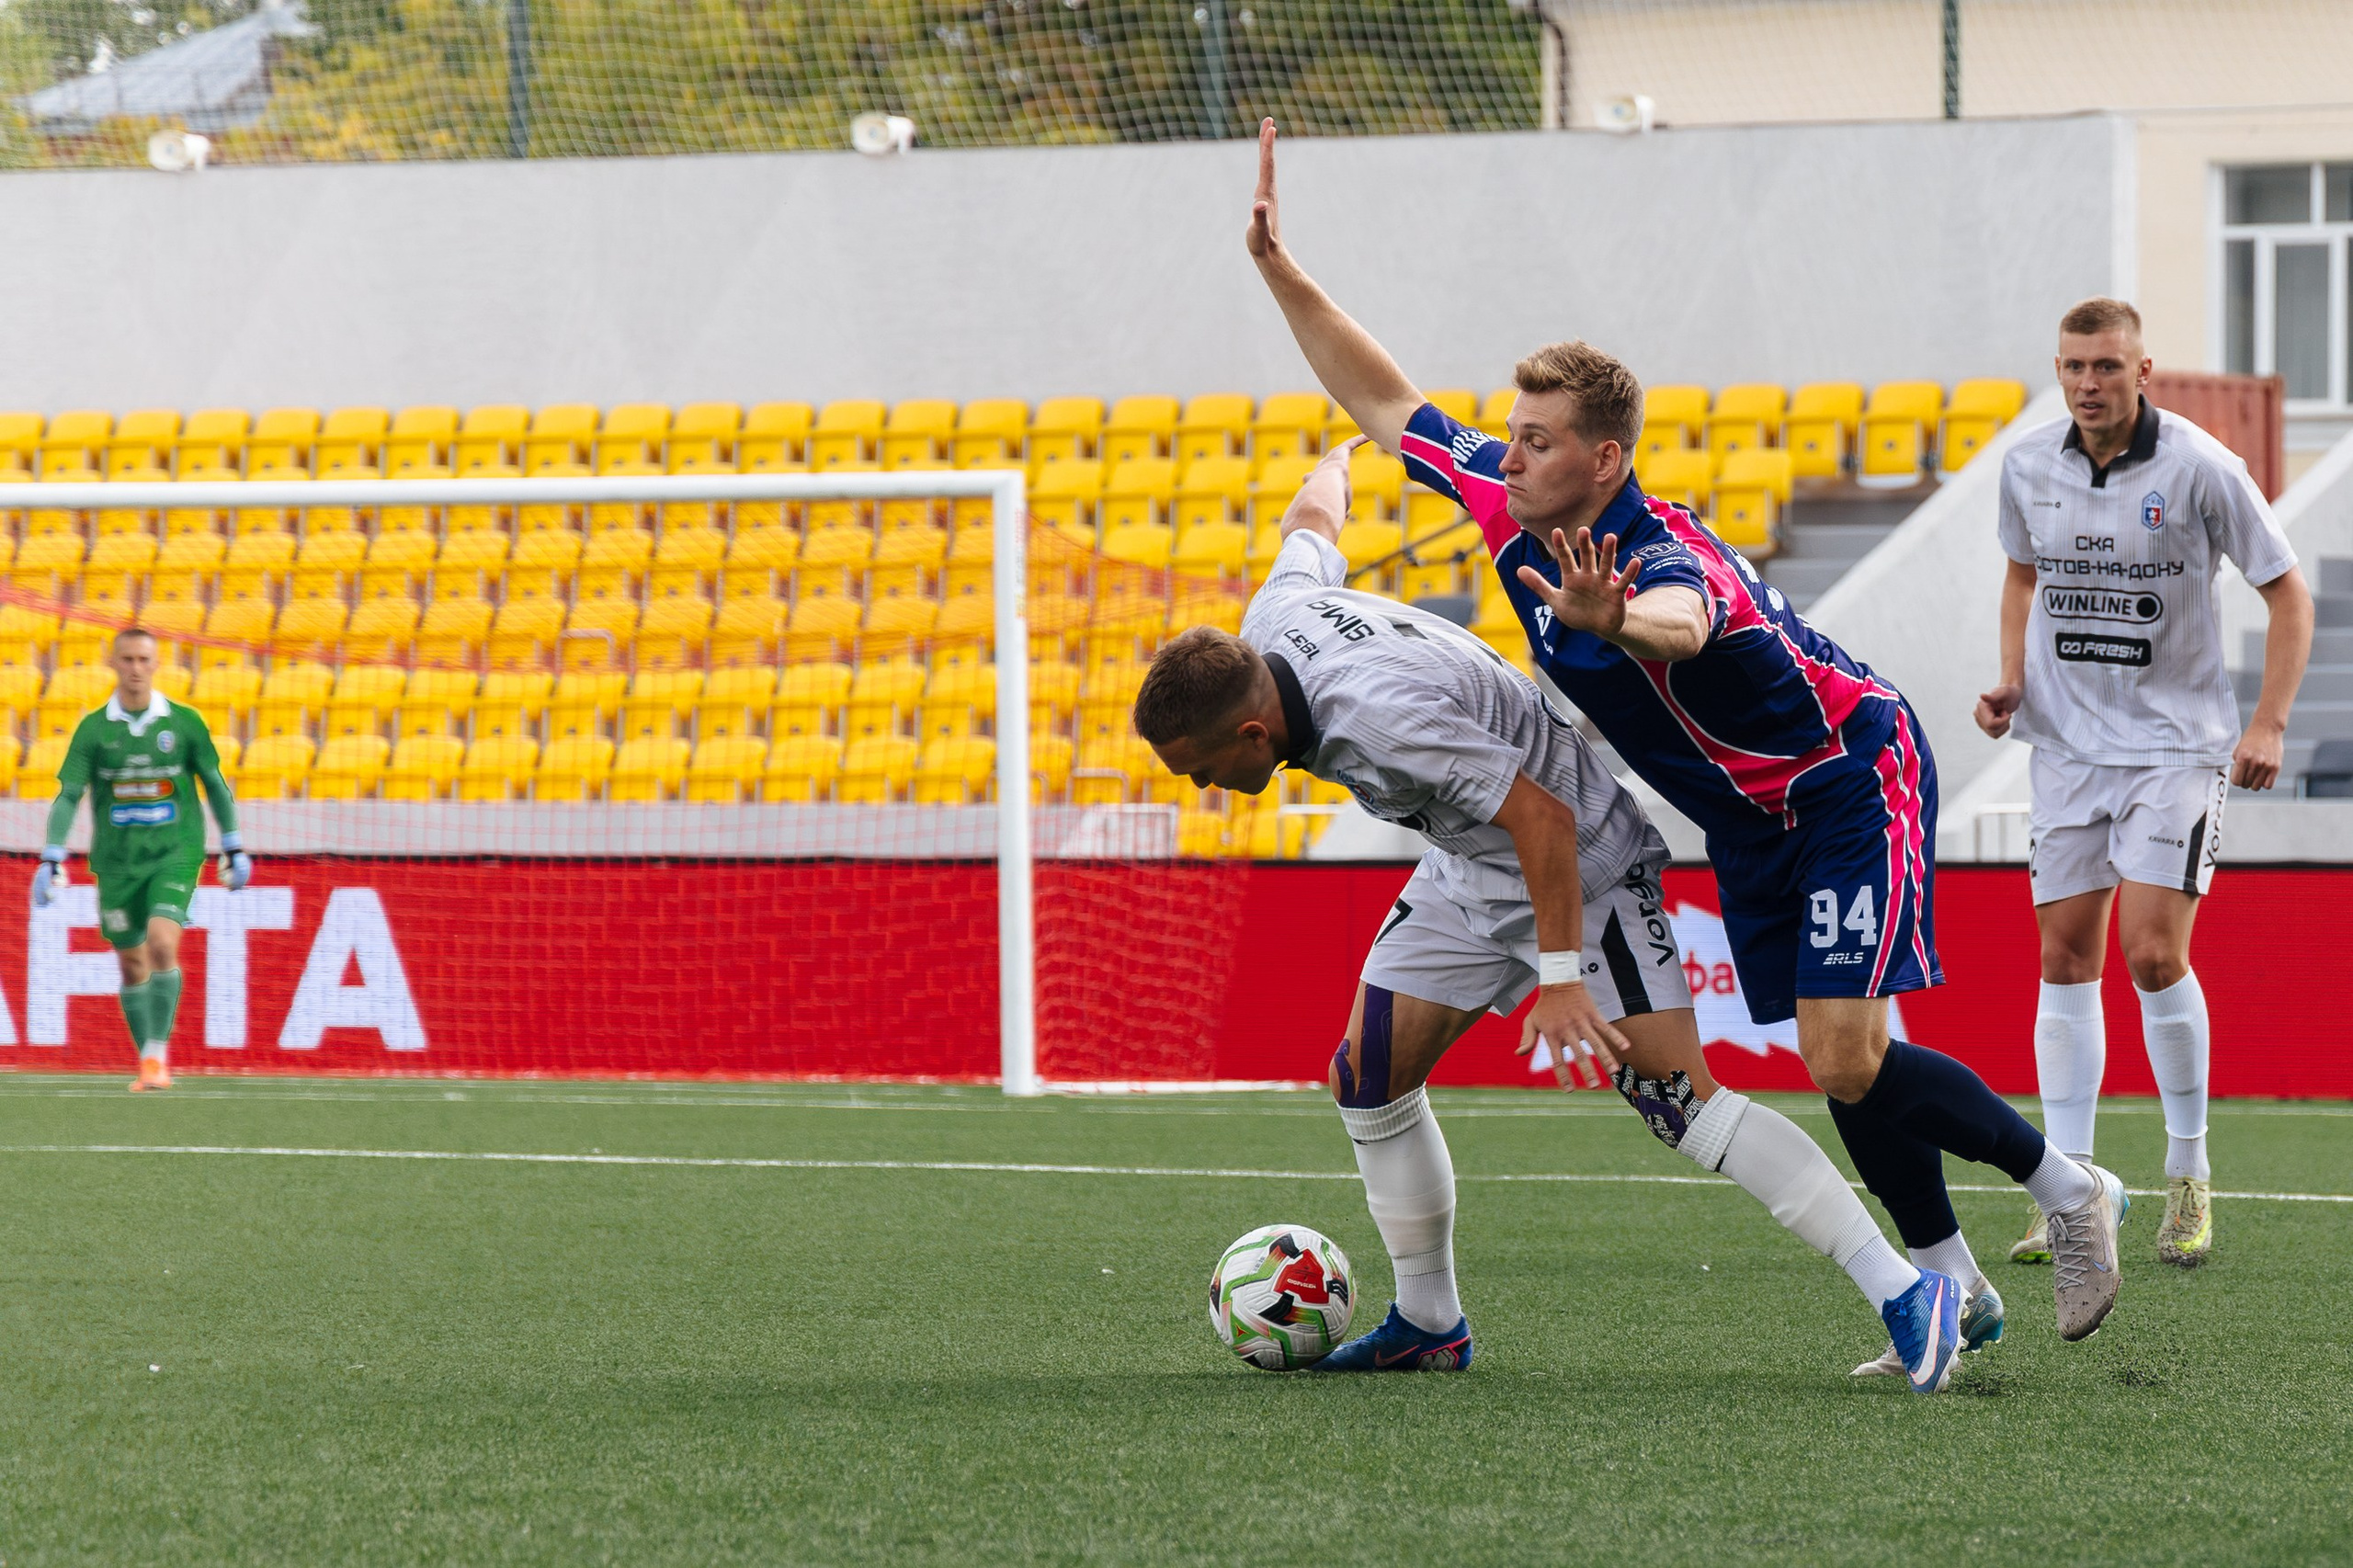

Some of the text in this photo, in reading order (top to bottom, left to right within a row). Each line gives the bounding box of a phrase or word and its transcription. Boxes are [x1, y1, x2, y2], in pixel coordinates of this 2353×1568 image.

[2075, 536, 2114, 552] СКА
[2035, 553, 2185, 581] ОСТОВ-НА-ДОНУ
[2049, 593, 2132, 615] WINLINE
[1305, 599, 1375, 642] SIMA
[1283, 629, 1320, 661] 1937
[1809, 885, 1877, 948] 94
[0, 885, 429, 1051] РТА
